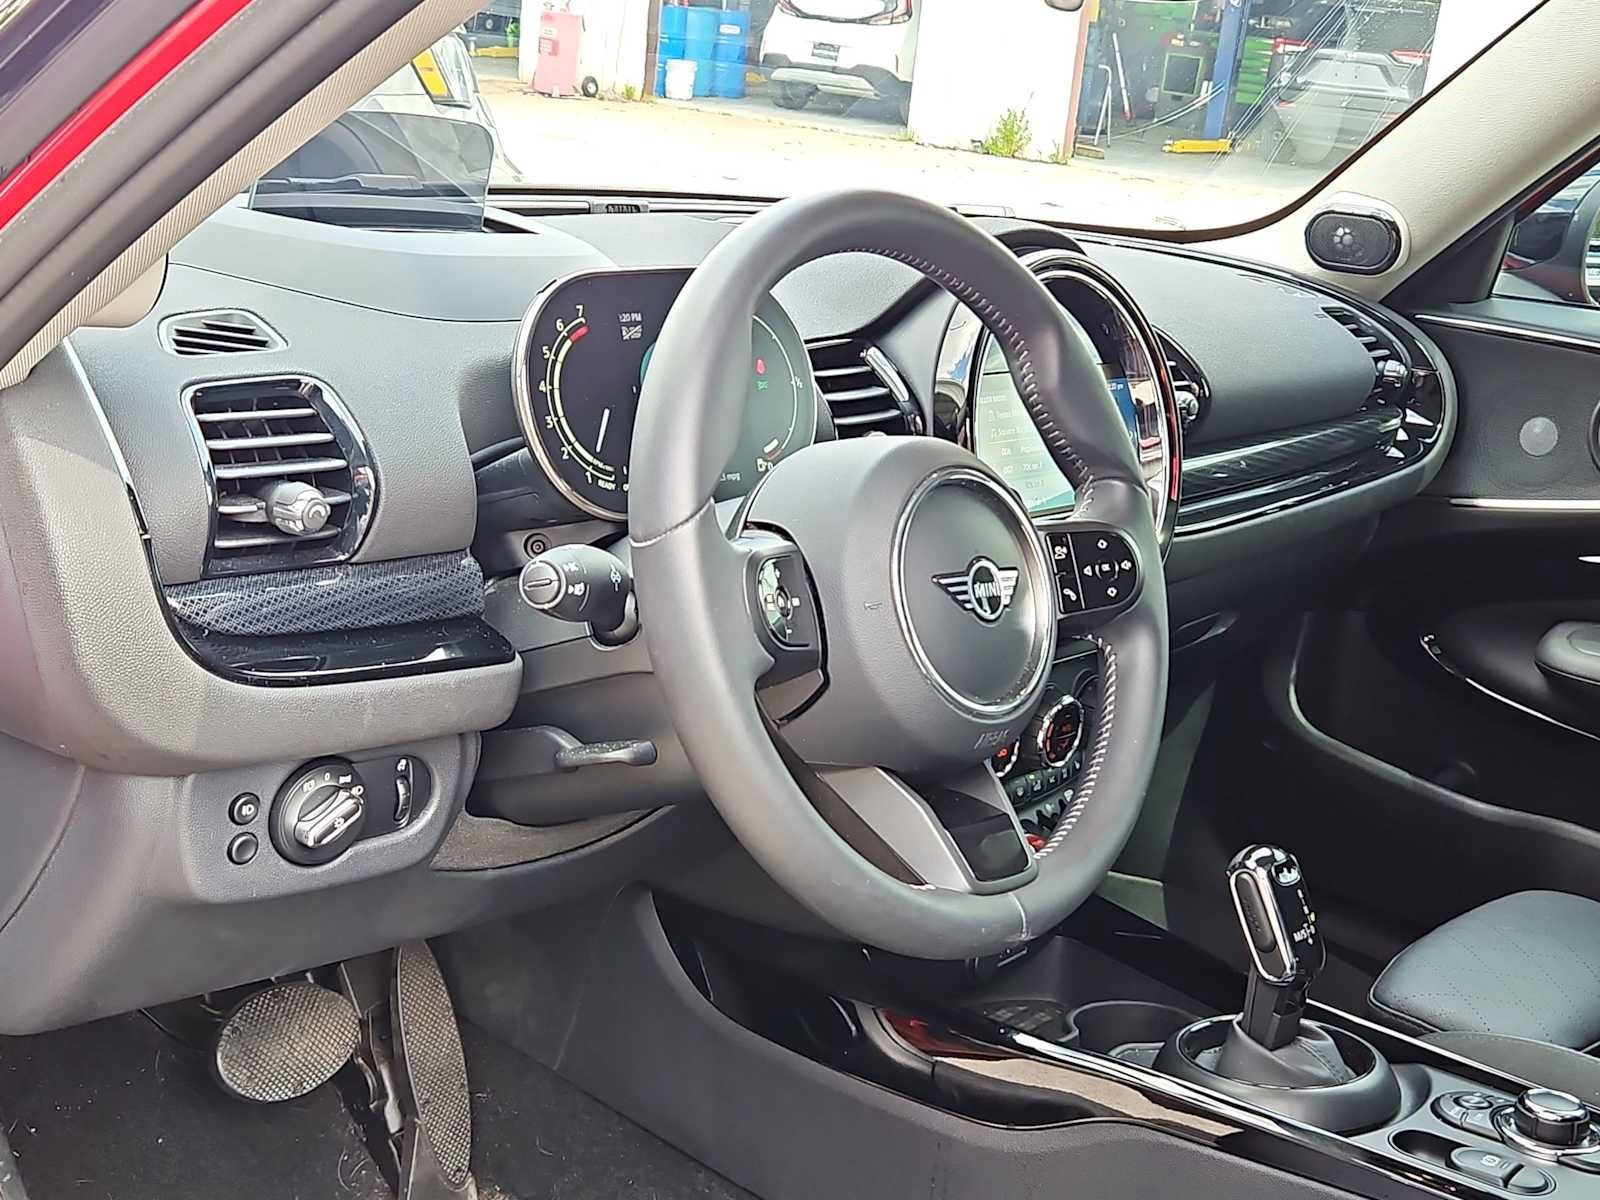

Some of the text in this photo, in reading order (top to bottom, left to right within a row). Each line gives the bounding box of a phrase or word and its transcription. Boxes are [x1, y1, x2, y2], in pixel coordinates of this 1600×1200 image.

[576, 305, 584, 317] 7
[556, 319, 564, 331] 6
[542, 346, 550, 359] 5
[539, 380, 546, 393] 4
[545, 416, 553, 429] 3
[561, 447, 569, 459] 2
[585, 471, 592, 484] 1
[973, 582, 1001, 599] MINI
